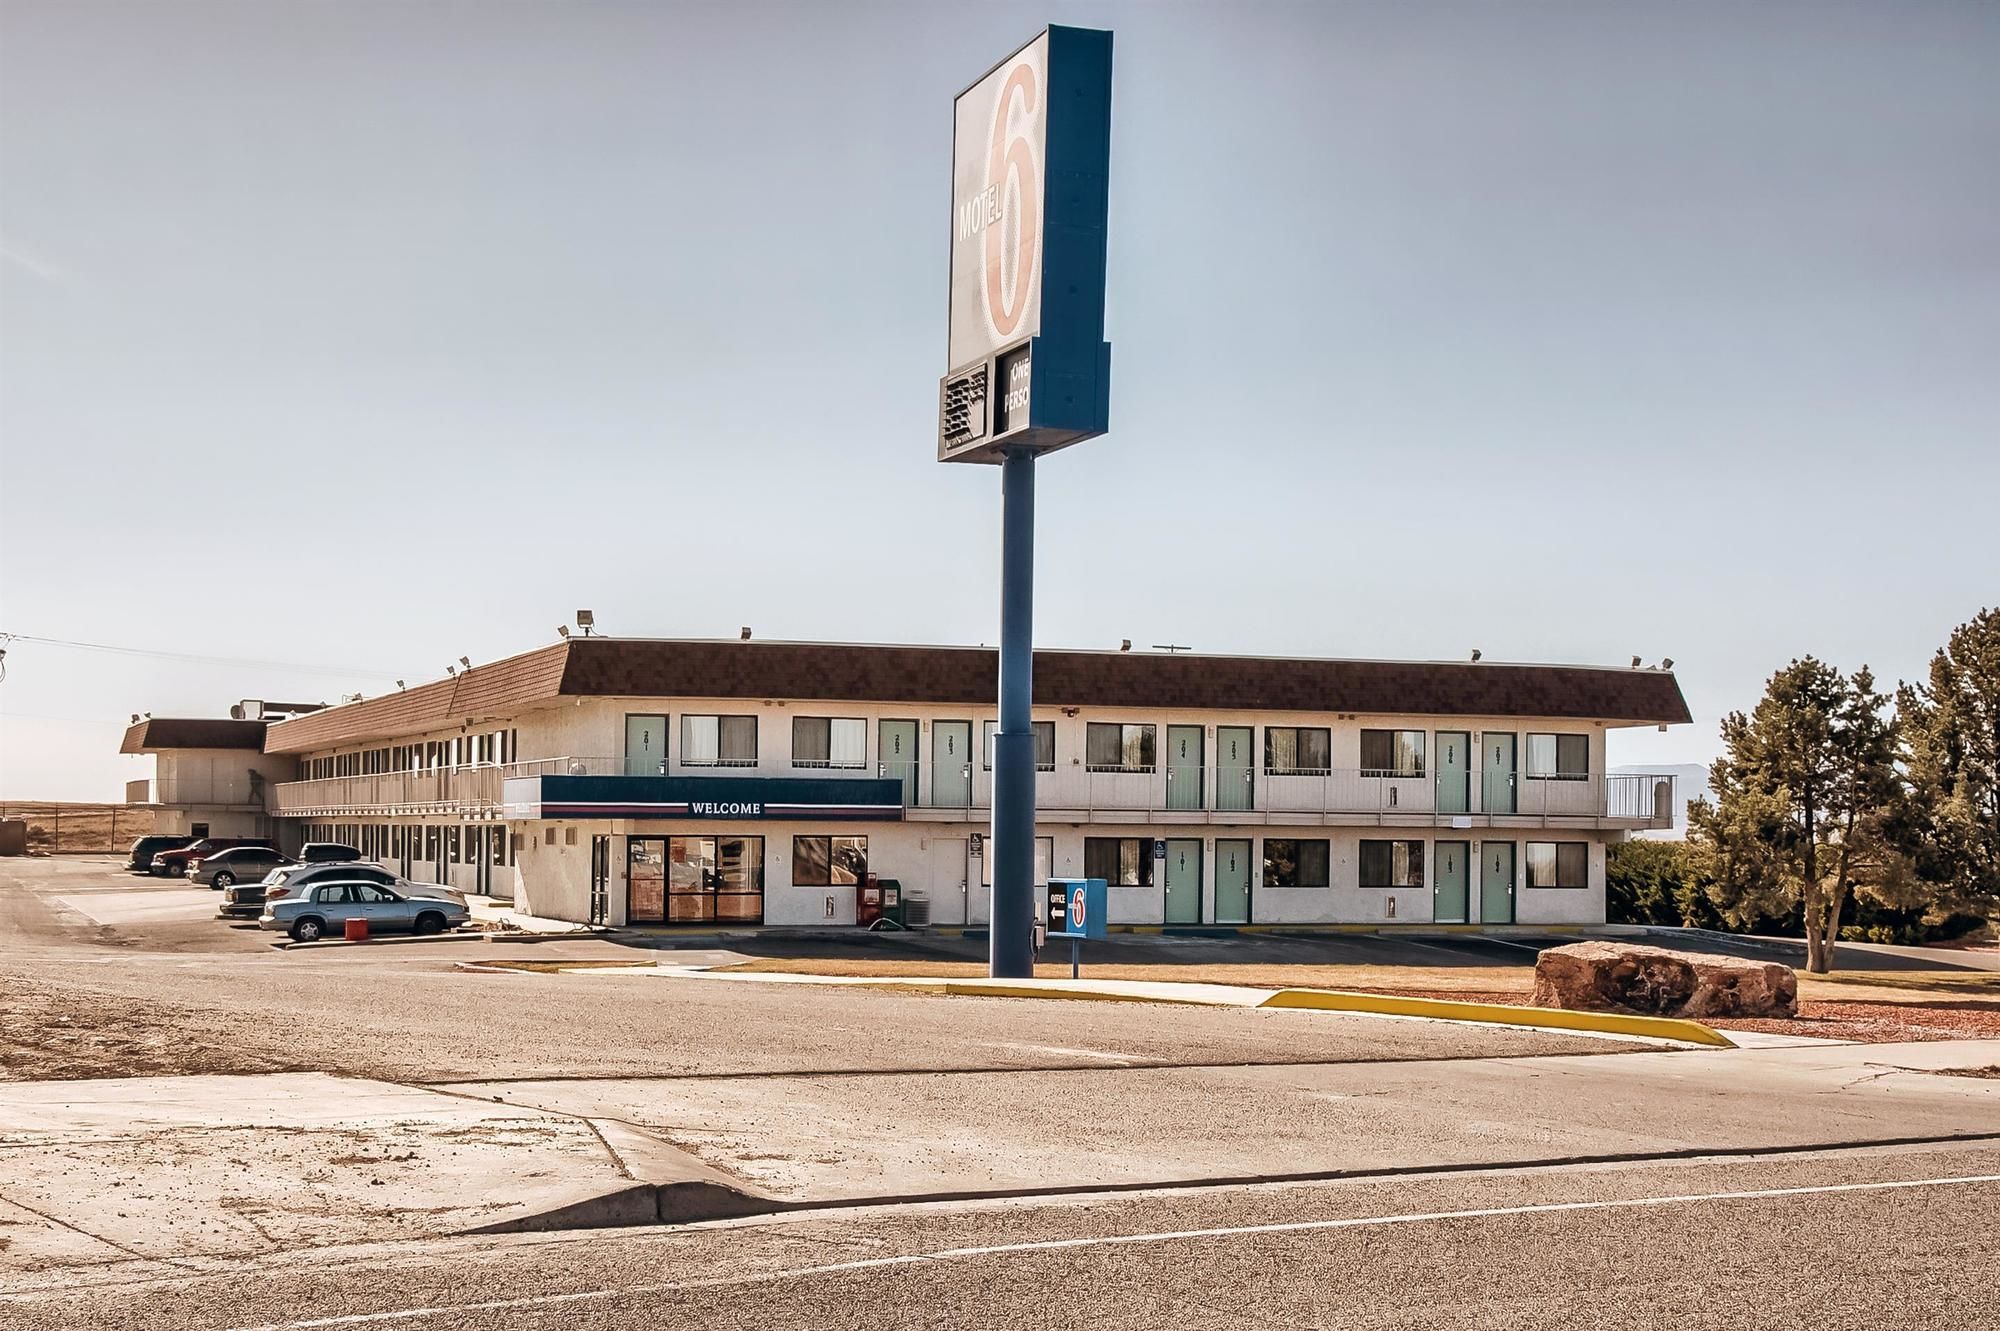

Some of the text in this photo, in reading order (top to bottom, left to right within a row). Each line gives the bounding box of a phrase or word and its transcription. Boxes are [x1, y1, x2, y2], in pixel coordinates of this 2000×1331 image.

[959, 63, 1037, 337] MOTEL 6
[1012, 357, 1030, 381] ONE
[692, 802, 761, 814] WELCOME
[1050, 894, 1066, 904] OFFICE
[1072, 888, 1086, 928] 6
